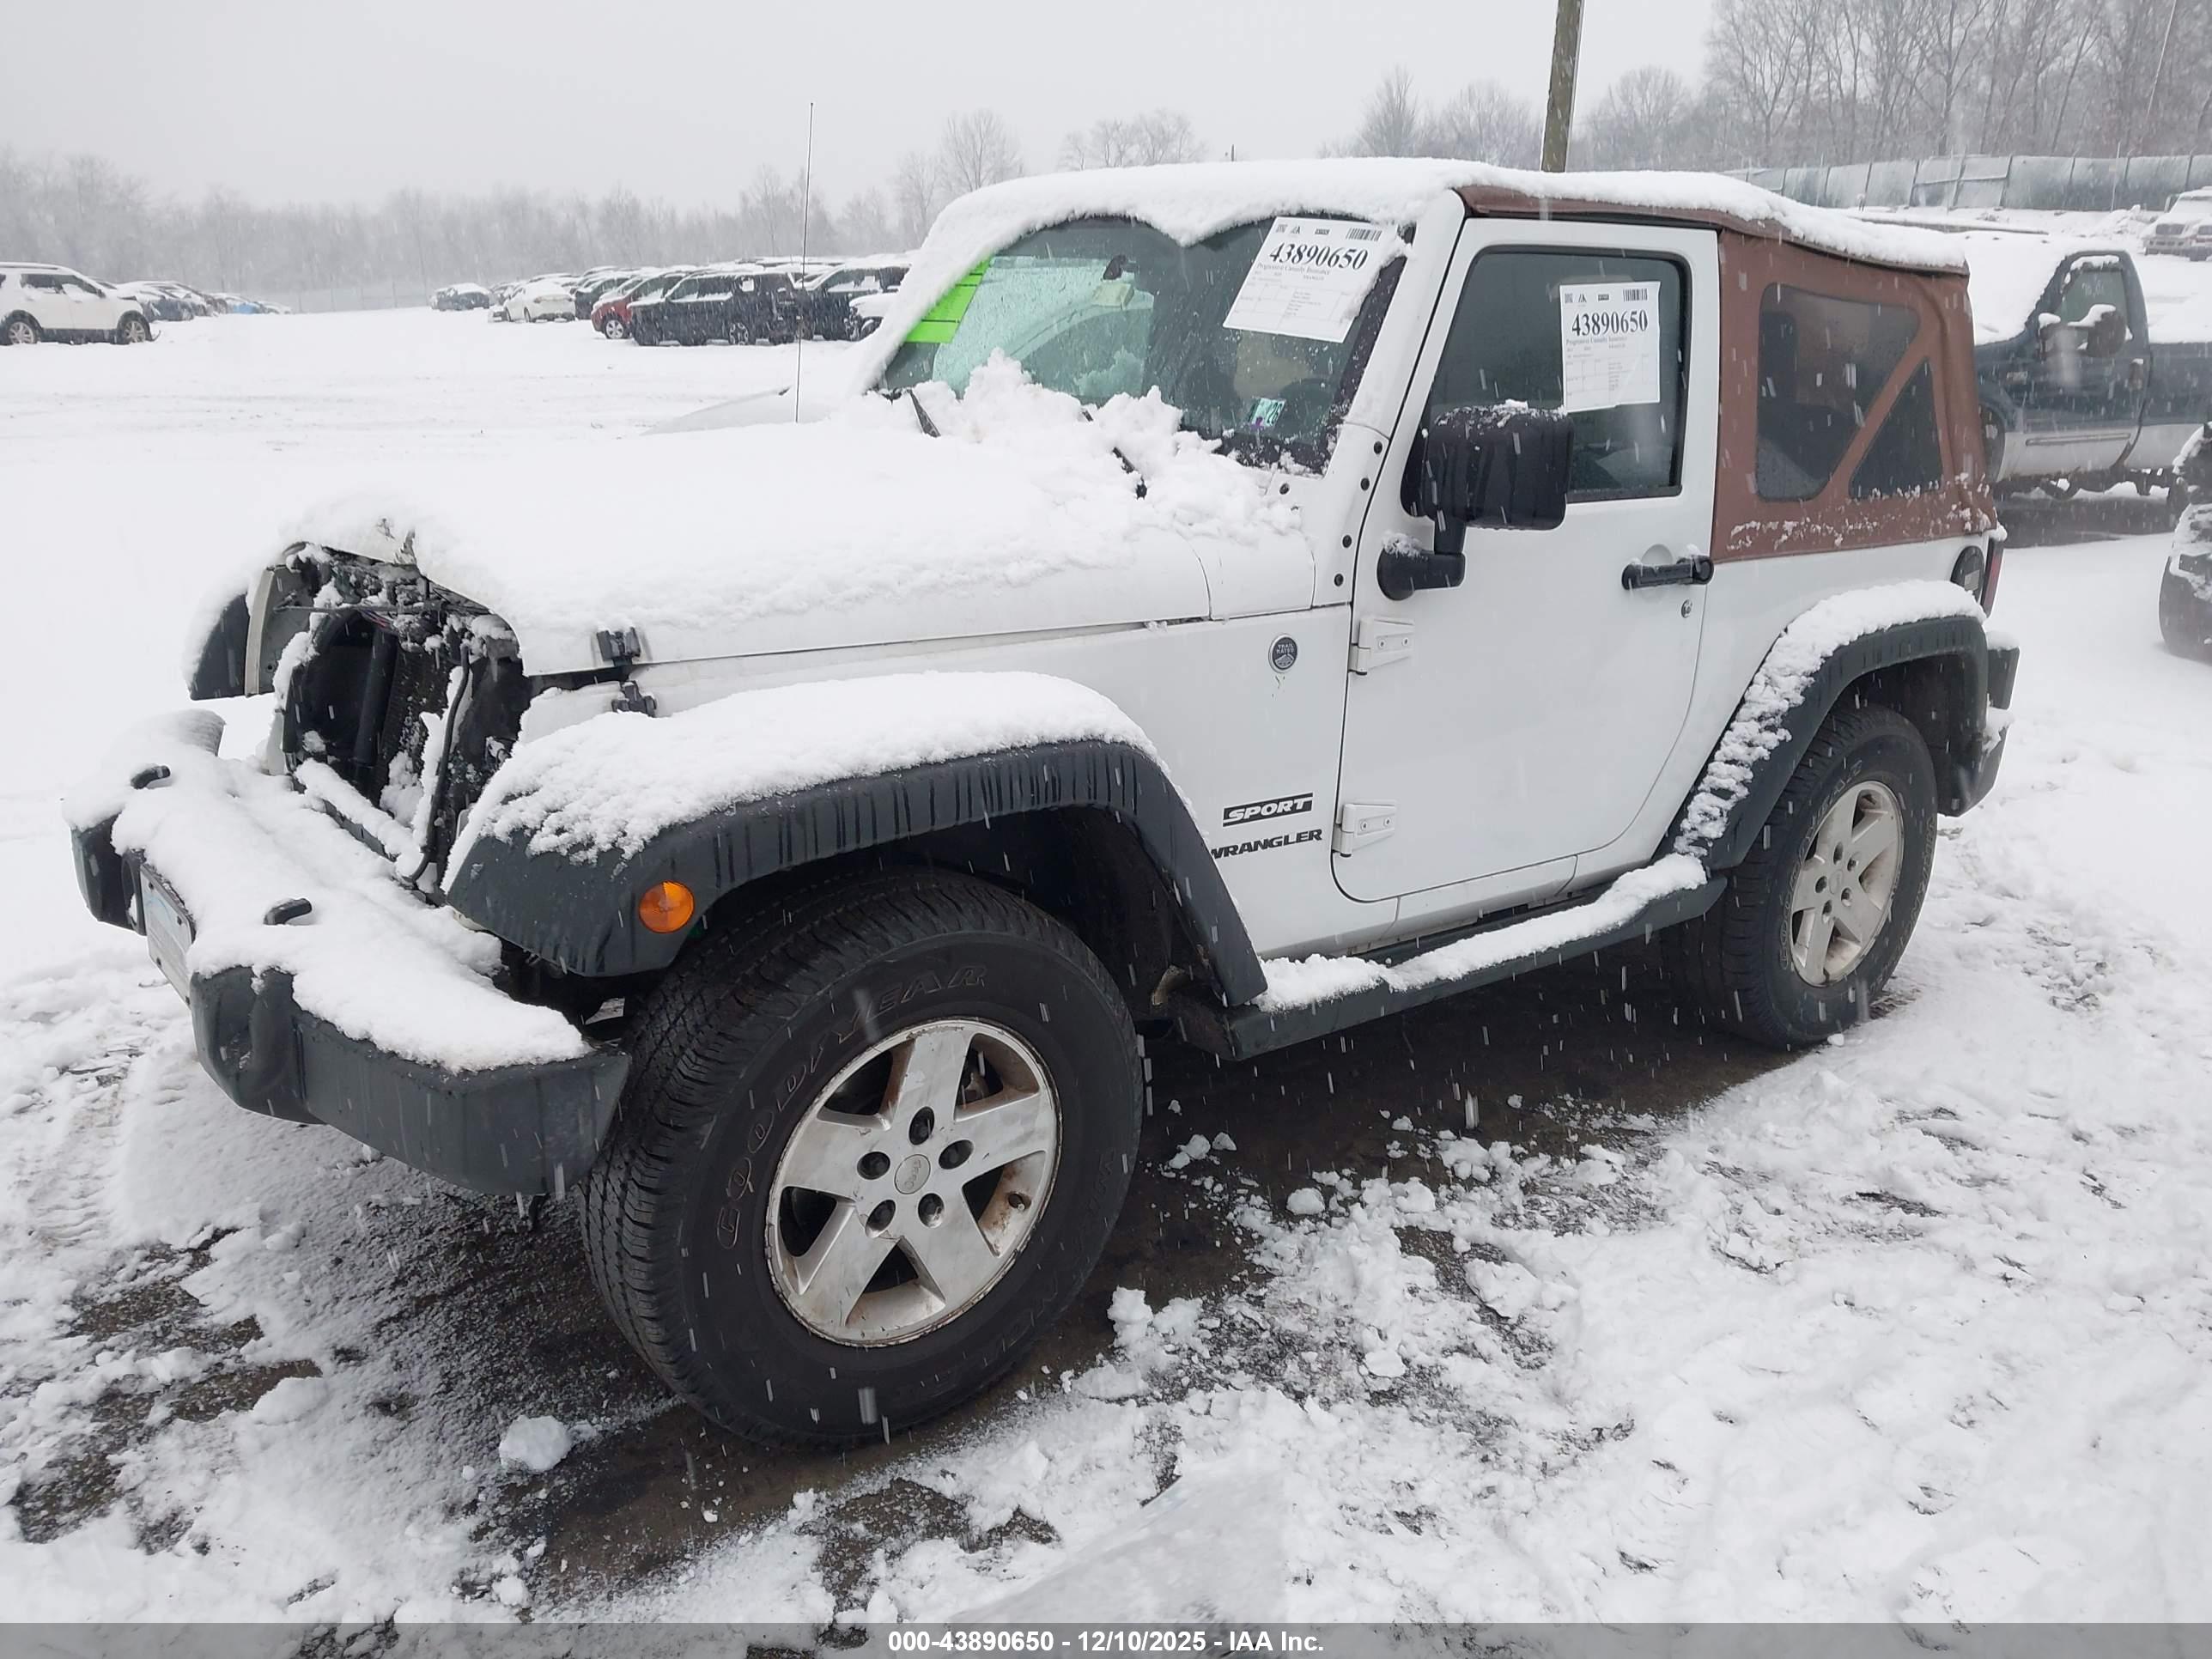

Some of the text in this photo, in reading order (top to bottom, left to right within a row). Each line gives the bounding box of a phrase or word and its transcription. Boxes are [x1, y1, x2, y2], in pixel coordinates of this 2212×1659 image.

[1269, 242, 1369, 270] 43890650
[1571, 309, 1649, 337] 43890650
[1224, 797, 1313, 823] SPORT
[1211, 829, 1322, 859] WRANGLER
